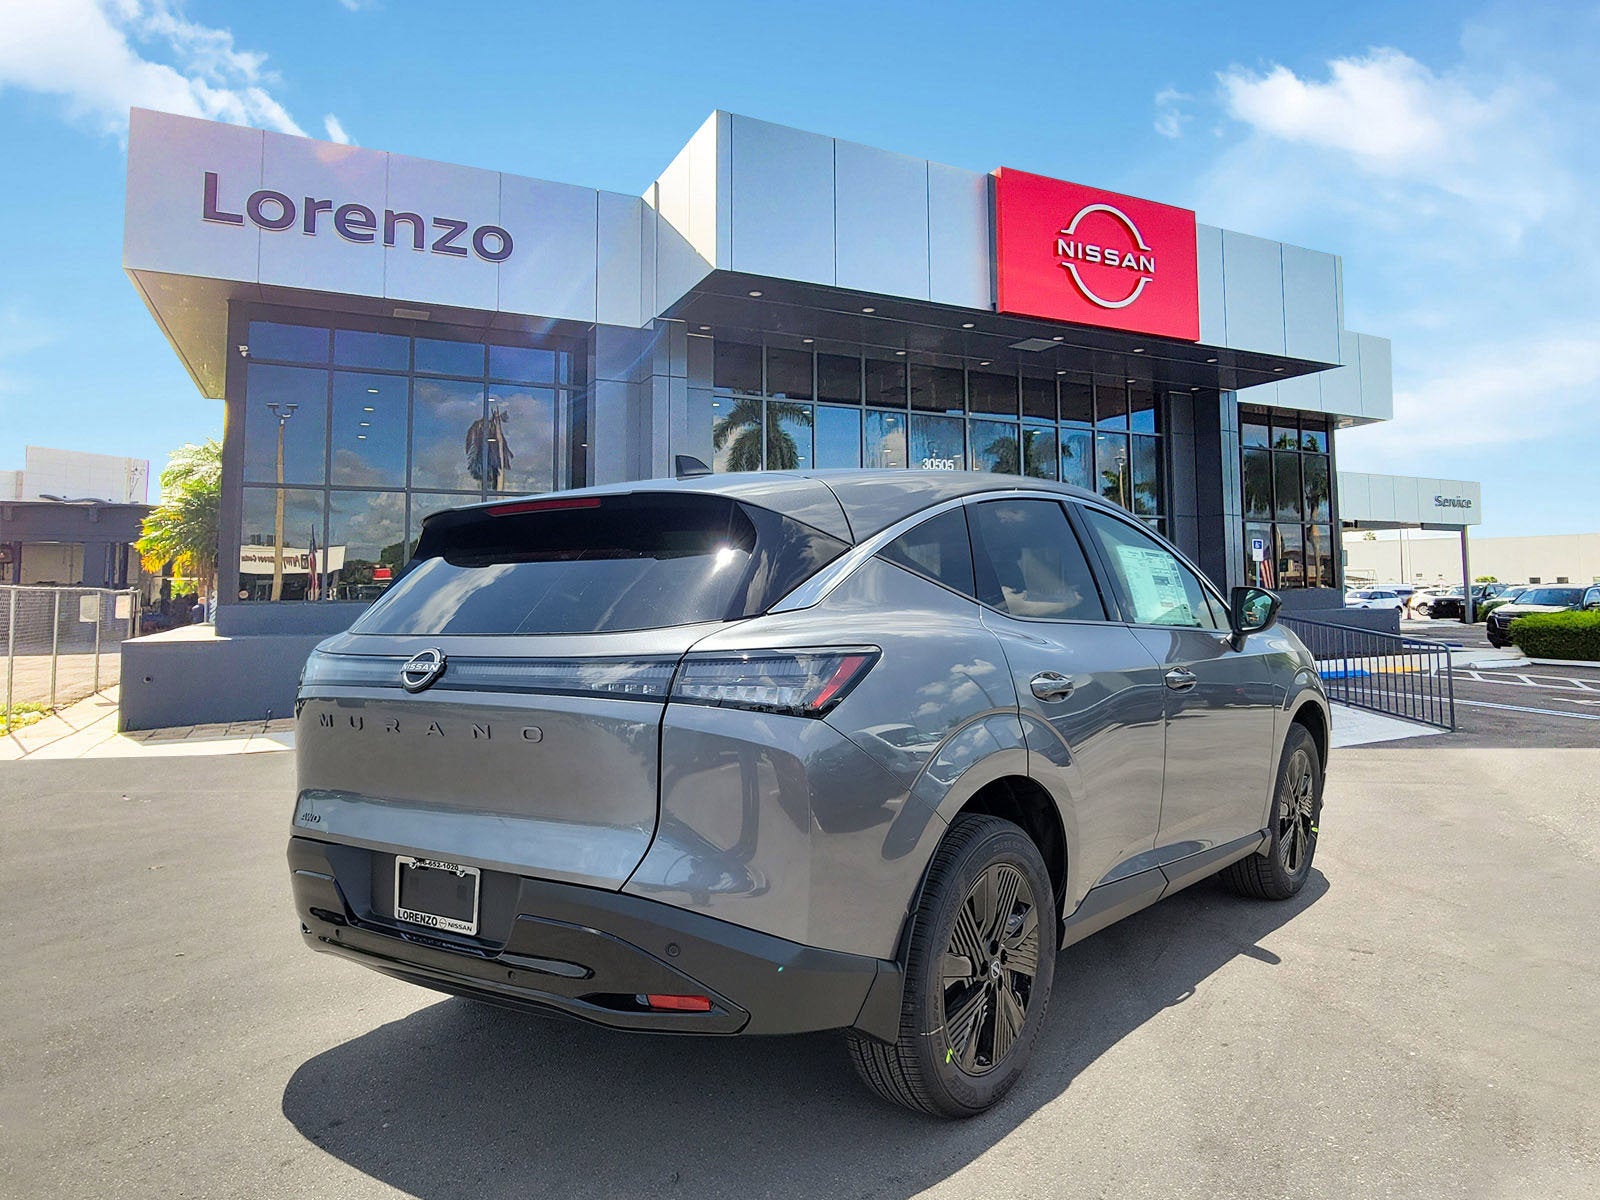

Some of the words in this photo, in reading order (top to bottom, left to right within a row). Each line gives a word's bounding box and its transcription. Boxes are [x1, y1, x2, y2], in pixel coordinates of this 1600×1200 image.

[202, 171, 514, 262] Lorenzo
[1057, 238, 1155, 273] NISSAN
[922, 457, 954, 471] 30505
[1434, 495, 1472, 509] Service
[402, 663, 439, 671] NISSAN
[319, 713, 545, 744] MURANO
[301, 812, 321, 823] AWD
[398, 910, 438, 926] LORENZO
[447, 922, 472, 931] NISSAN
